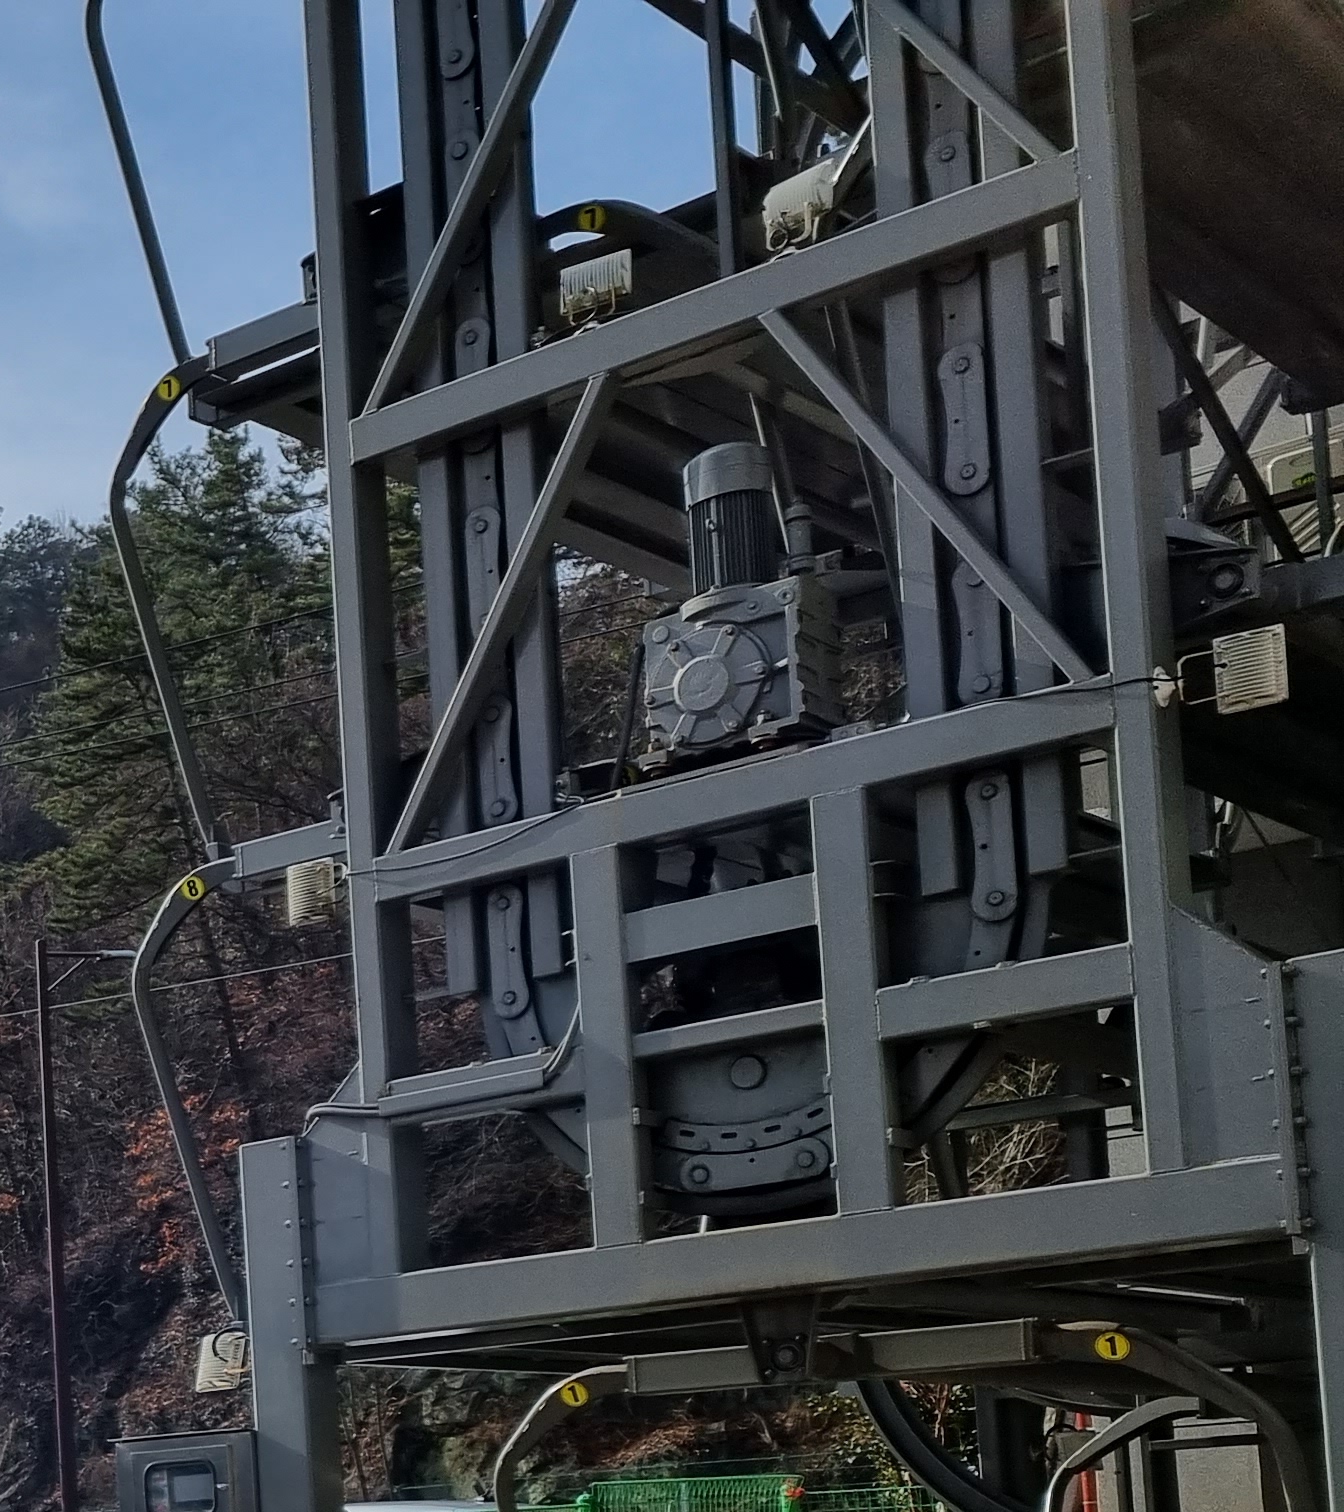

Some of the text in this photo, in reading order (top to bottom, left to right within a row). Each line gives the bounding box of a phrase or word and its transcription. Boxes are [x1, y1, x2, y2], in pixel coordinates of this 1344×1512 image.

[186, 879, 199, 898] 8
[1105, 1336, 1117, 1356] 1
[567, 1386, 579, 1403] 1
